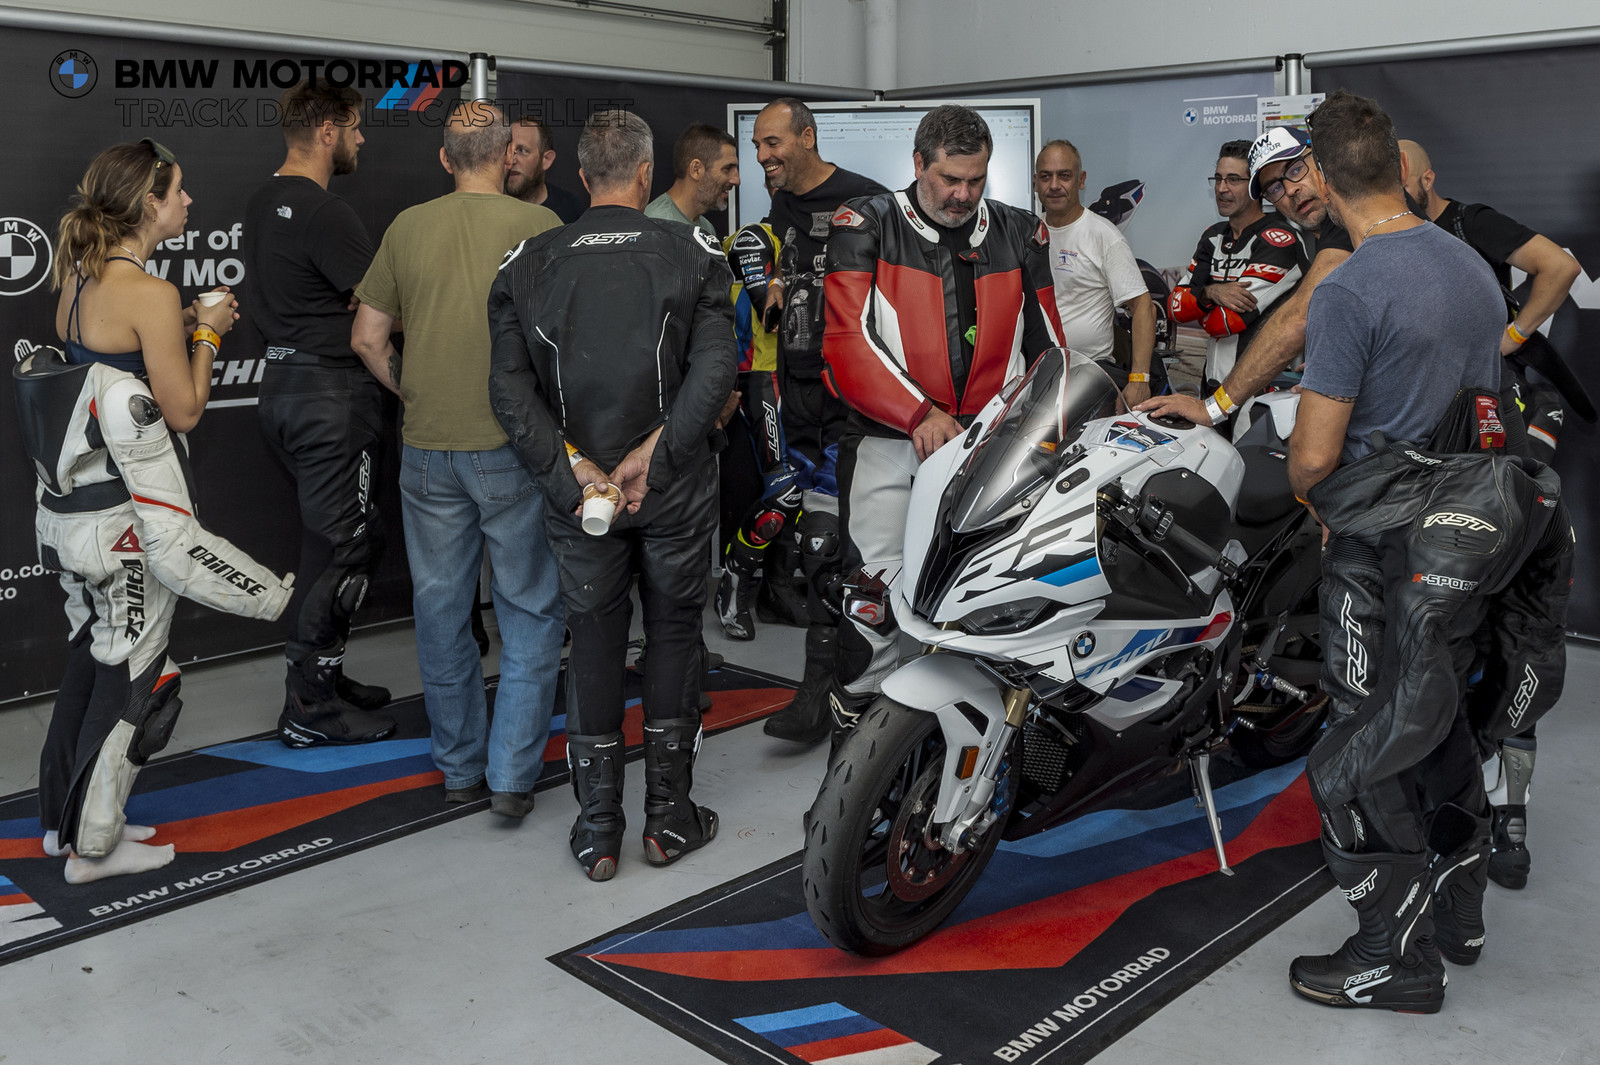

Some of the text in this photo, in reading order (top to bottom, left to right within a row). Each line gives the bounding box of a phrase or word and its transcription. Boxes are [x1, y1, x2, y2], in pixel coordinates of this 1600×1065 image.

[1203, 106, 1228, 115] BMW
[1203, 114, 1258, 125] MOTORRAD
[208, 223, 243, 250] of
[571, 232, 642, 247] RST
[762, 400, 781, 462] RST
[1405, 450, 1442, 465] RST
[1423, 512, 1497, 532] RST
[187, 545, 268, 597] DAINESE
[120, 559, 145, 646] DAINESE
[1340, 592, 1370, 696] RST
[1507, 663, 1539, 728] RST
[89, 837, 334, 917] BMW MOTORRAD
[1341, 868, 1378, 901] RST
[1343, 965, 1390, 989] RST
[993, 947, 1171, 1062] BMW MOTORRAD
